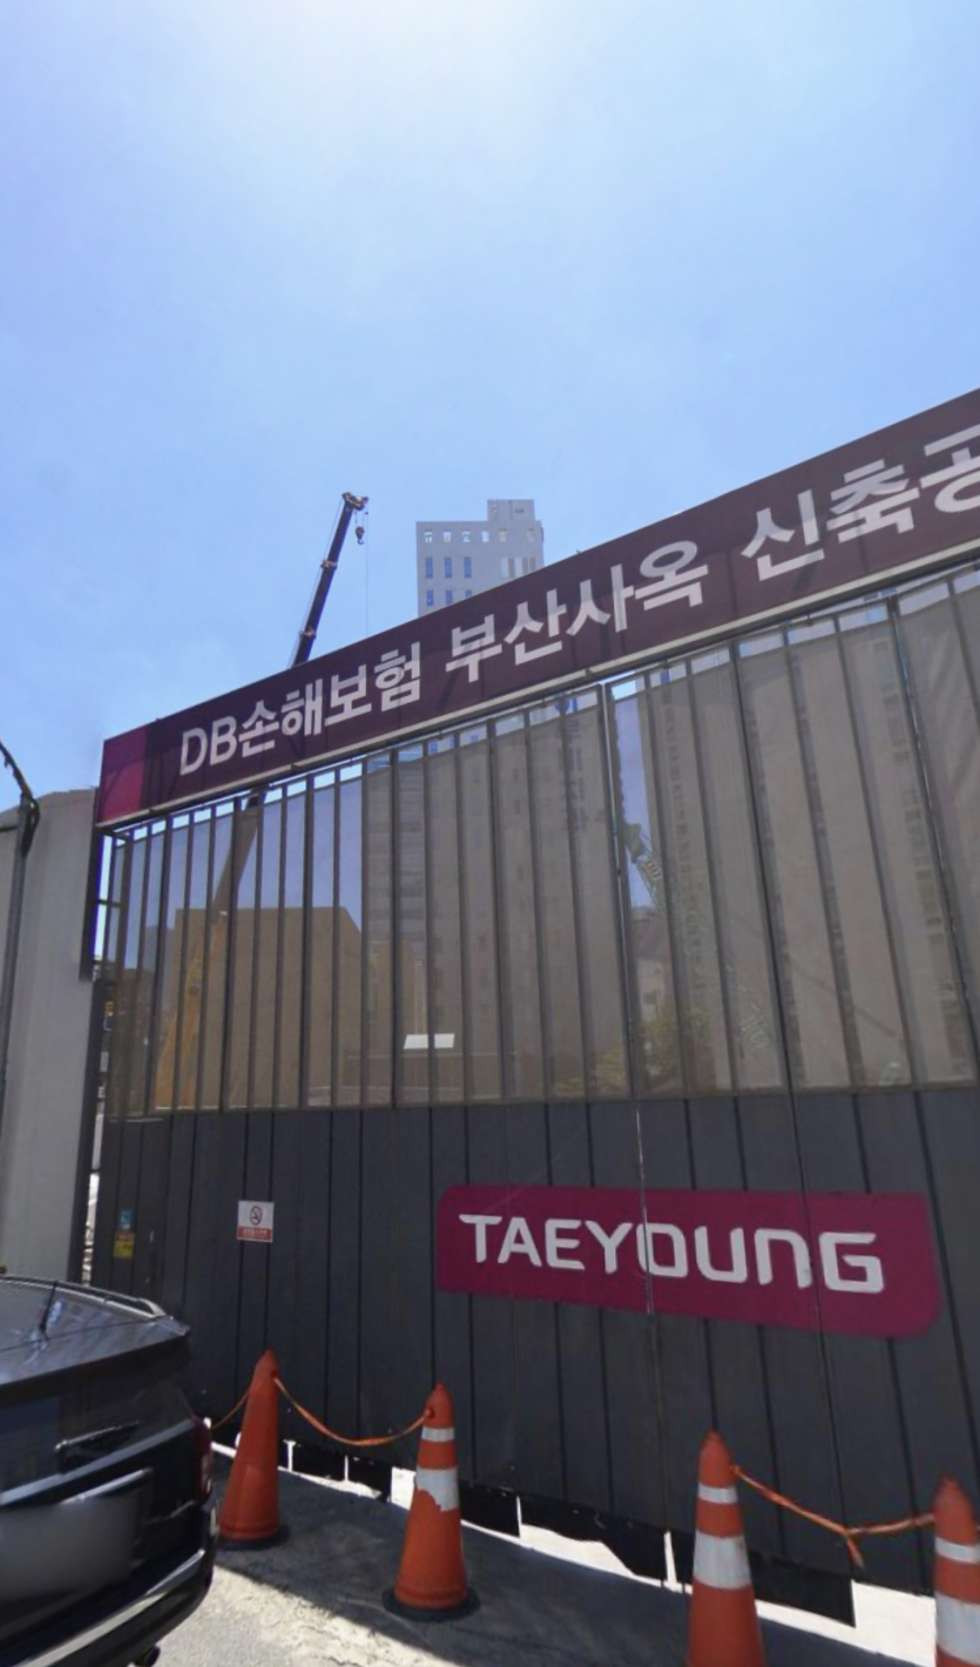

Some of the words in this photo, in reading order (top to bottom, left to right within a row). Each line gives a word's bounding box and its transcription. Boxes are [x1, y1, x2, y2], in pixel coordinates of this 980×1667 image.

[180, 641, 422, 776] DB손해보험
[445, 540, 709, 683] 부산사옥
[458, 1213, 885, 1294] TAEYOUNG
